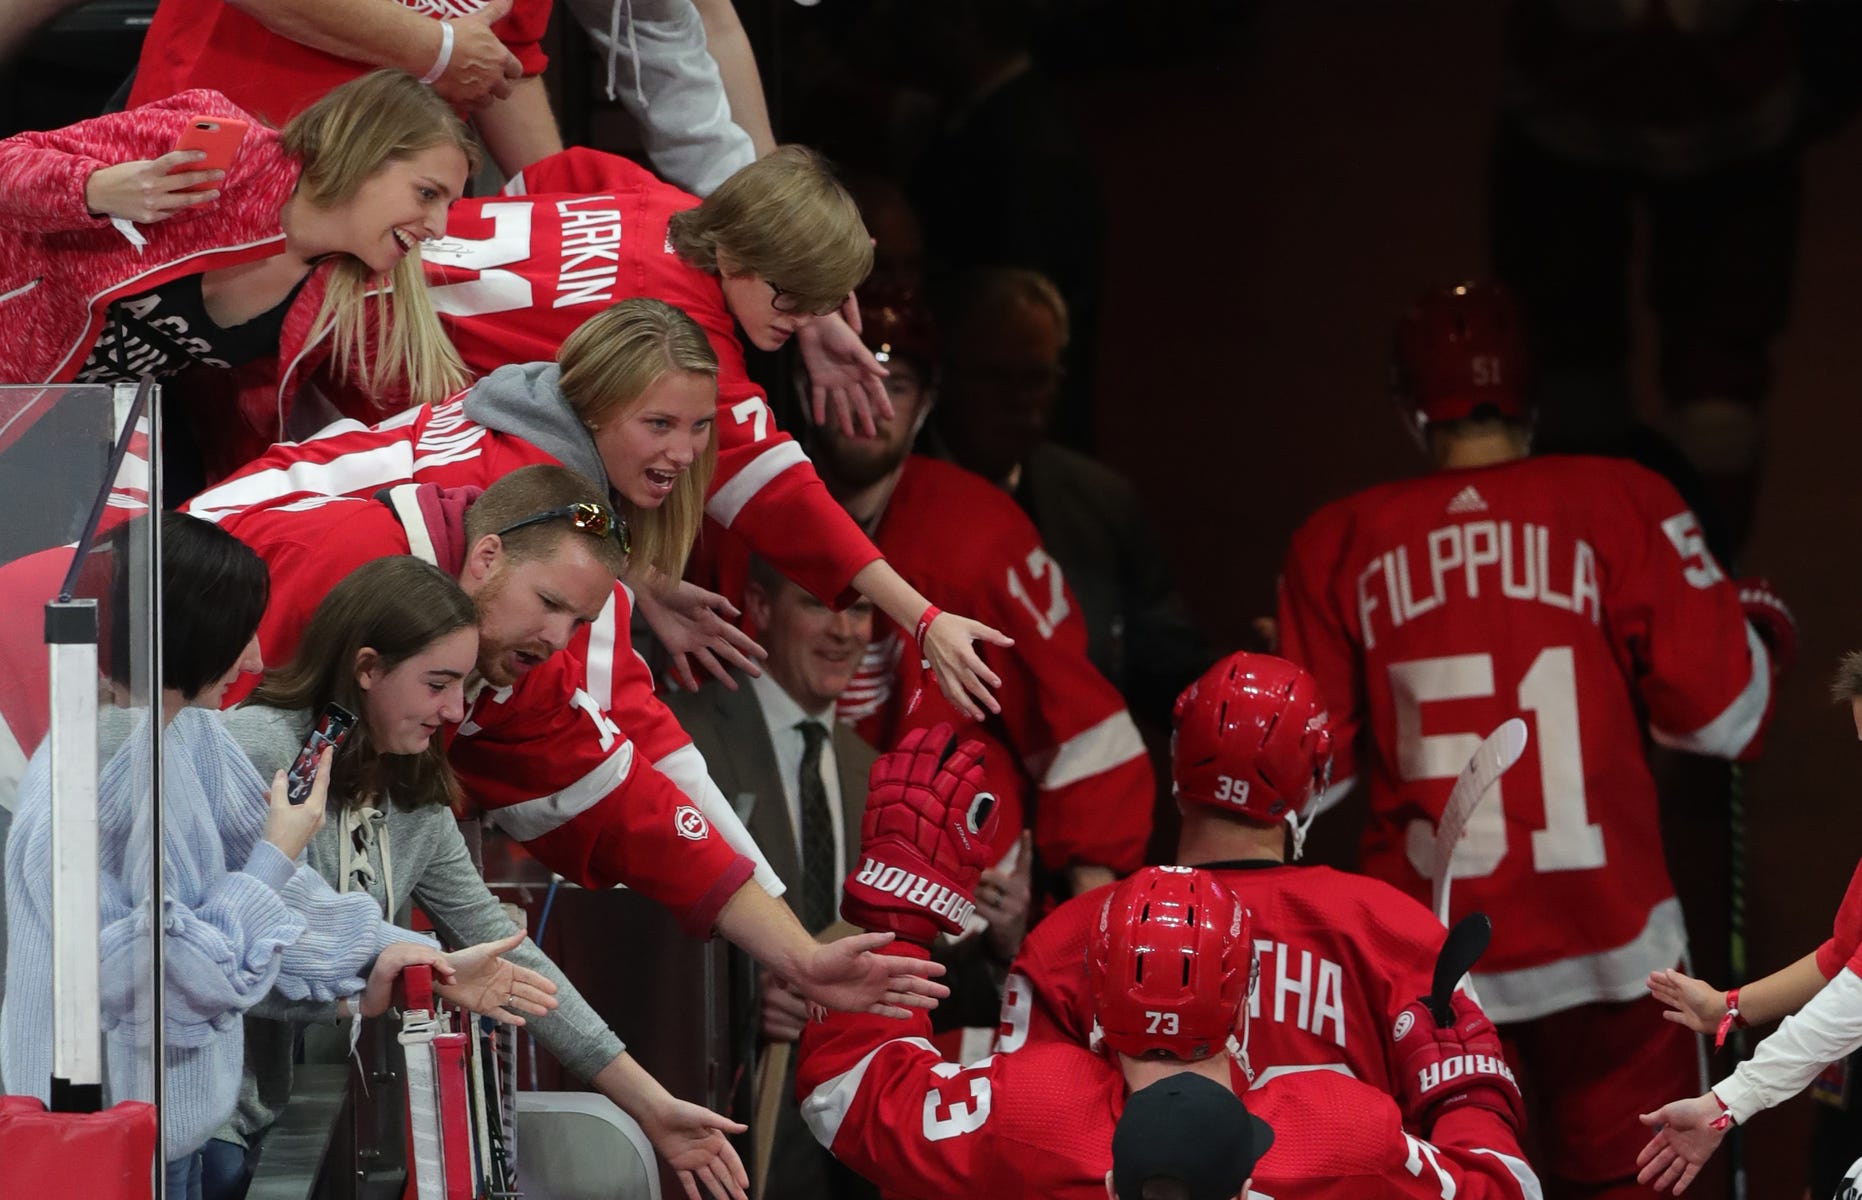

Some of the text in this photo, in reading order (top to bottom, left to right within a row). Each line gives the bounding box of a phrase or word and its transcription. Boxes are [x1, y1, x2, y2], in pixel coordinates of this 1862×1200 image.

[553, 196, 622, 308] LARKIN
[1472, 357, 1501, 385] 51
[732, 396, 767, 442] 7
[1358, 520, 1598, 648] FILPPULA
[1214, 775, 1249, 804] 39
[1388, 646, 1606, 880] 51
[1145, 1011, 1179, 1036] 73
[1250, 939, 1346, 1047] THA
